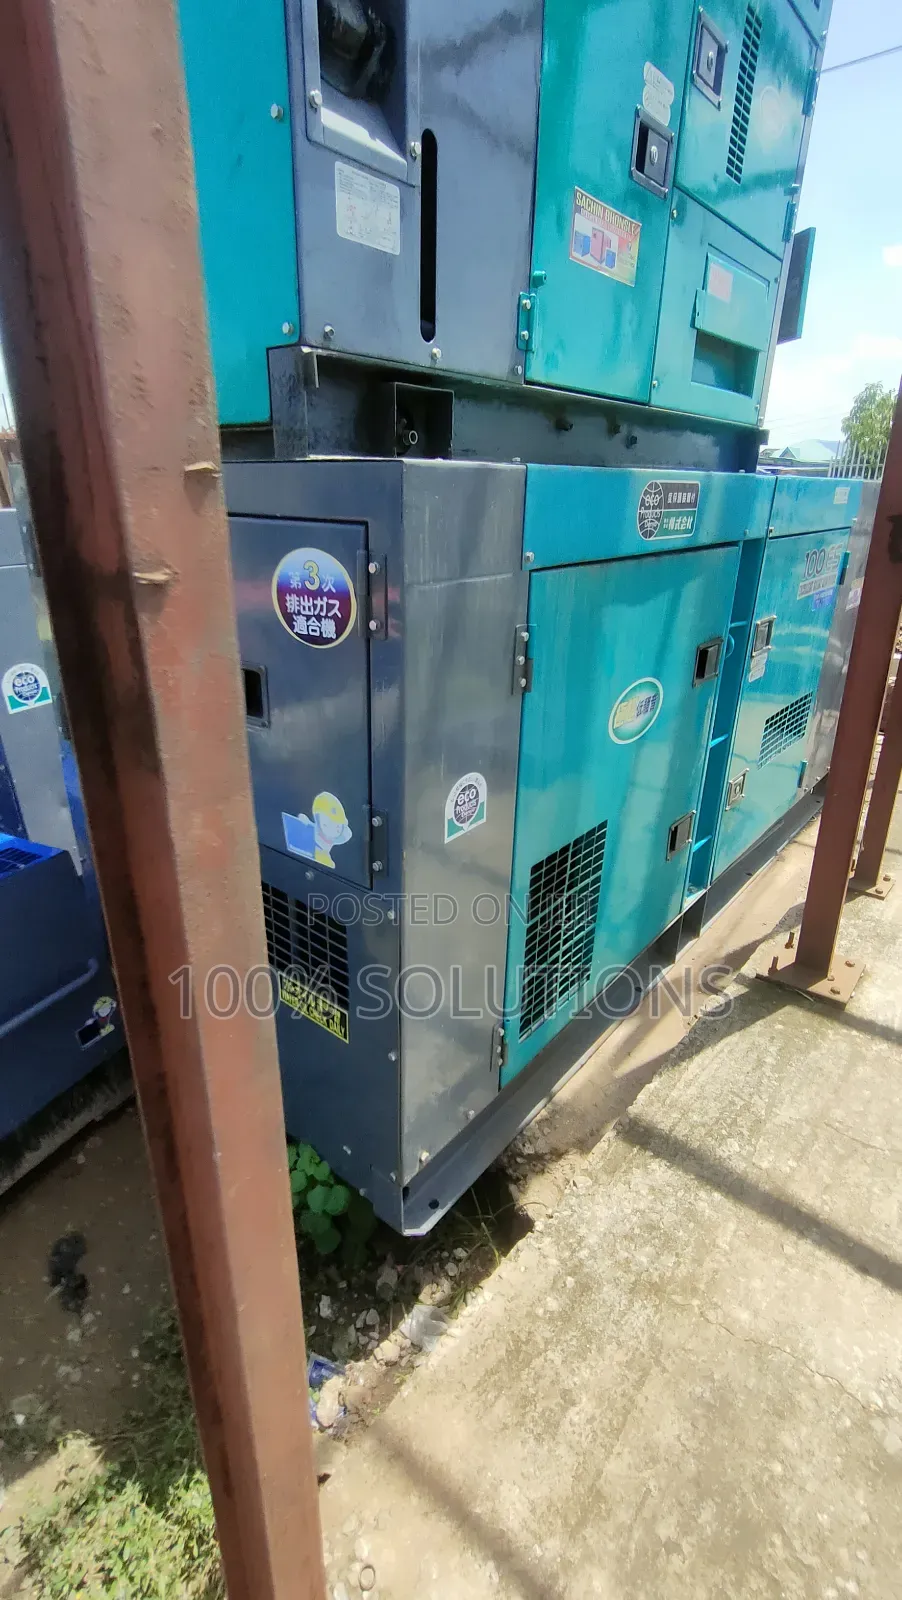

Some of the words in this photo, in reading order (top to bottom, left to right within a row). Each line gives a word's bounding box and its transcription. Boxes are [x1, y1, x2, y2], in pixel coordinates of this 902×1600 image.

[576, 191, 604, 220] SACHIN
[605, 208, 636, 235] BHONSLE
[645, 493, 660, 506] eco
[804, 548, 826, 579] 100
[288, 560, 336, 593] 第3次
[285, 593, 341, 618] 排出ガス
[293, 614, 336, 639] 適合機
[14, 675, 35, 687] eco
[457, 788, 476, 806] eco
[329, 1018, 346, 1038] DAILY
